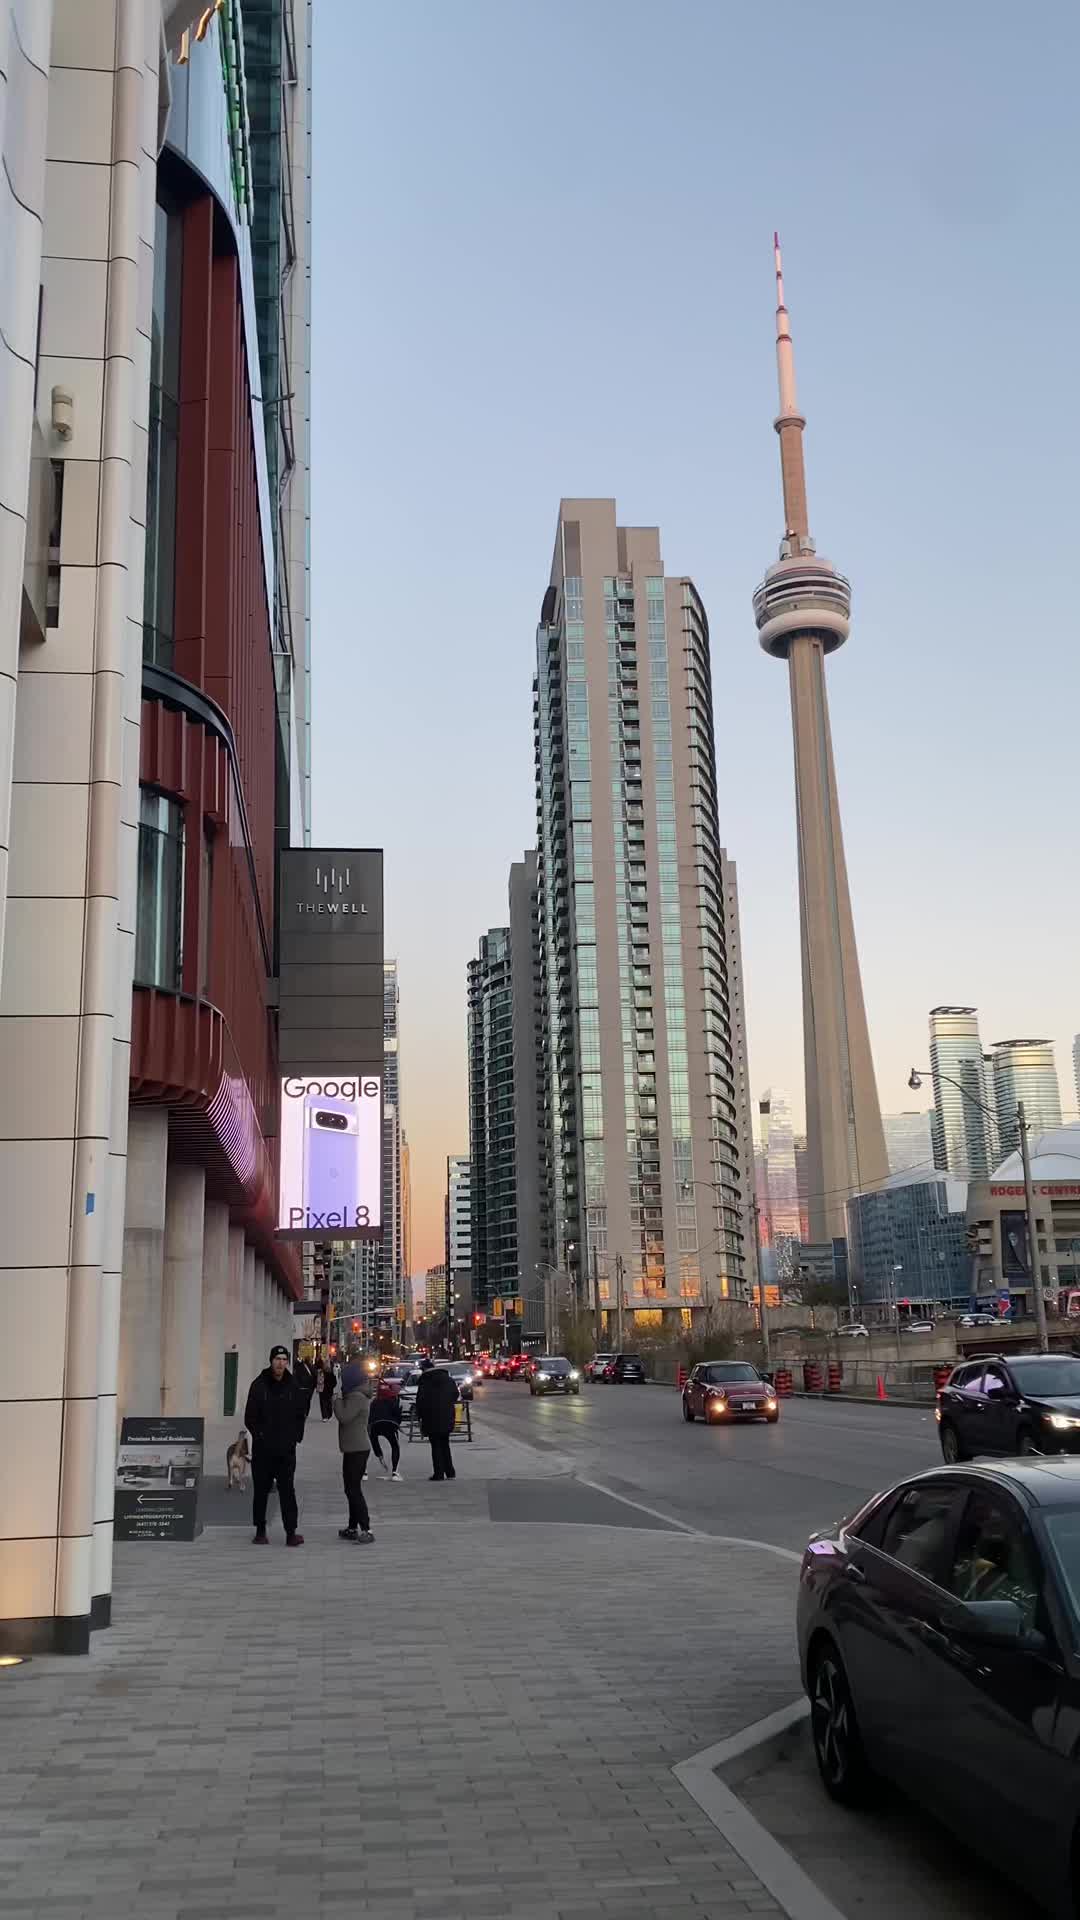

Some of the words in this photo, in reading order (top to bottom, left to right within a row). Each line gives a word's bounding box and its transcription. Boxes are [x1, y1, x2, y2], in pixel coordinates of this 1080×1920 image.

[283, 1076, 379, 1102] Google
[289, 1206, 348, 1229] Pixel
[355, 1205, 370, 1228] 8
